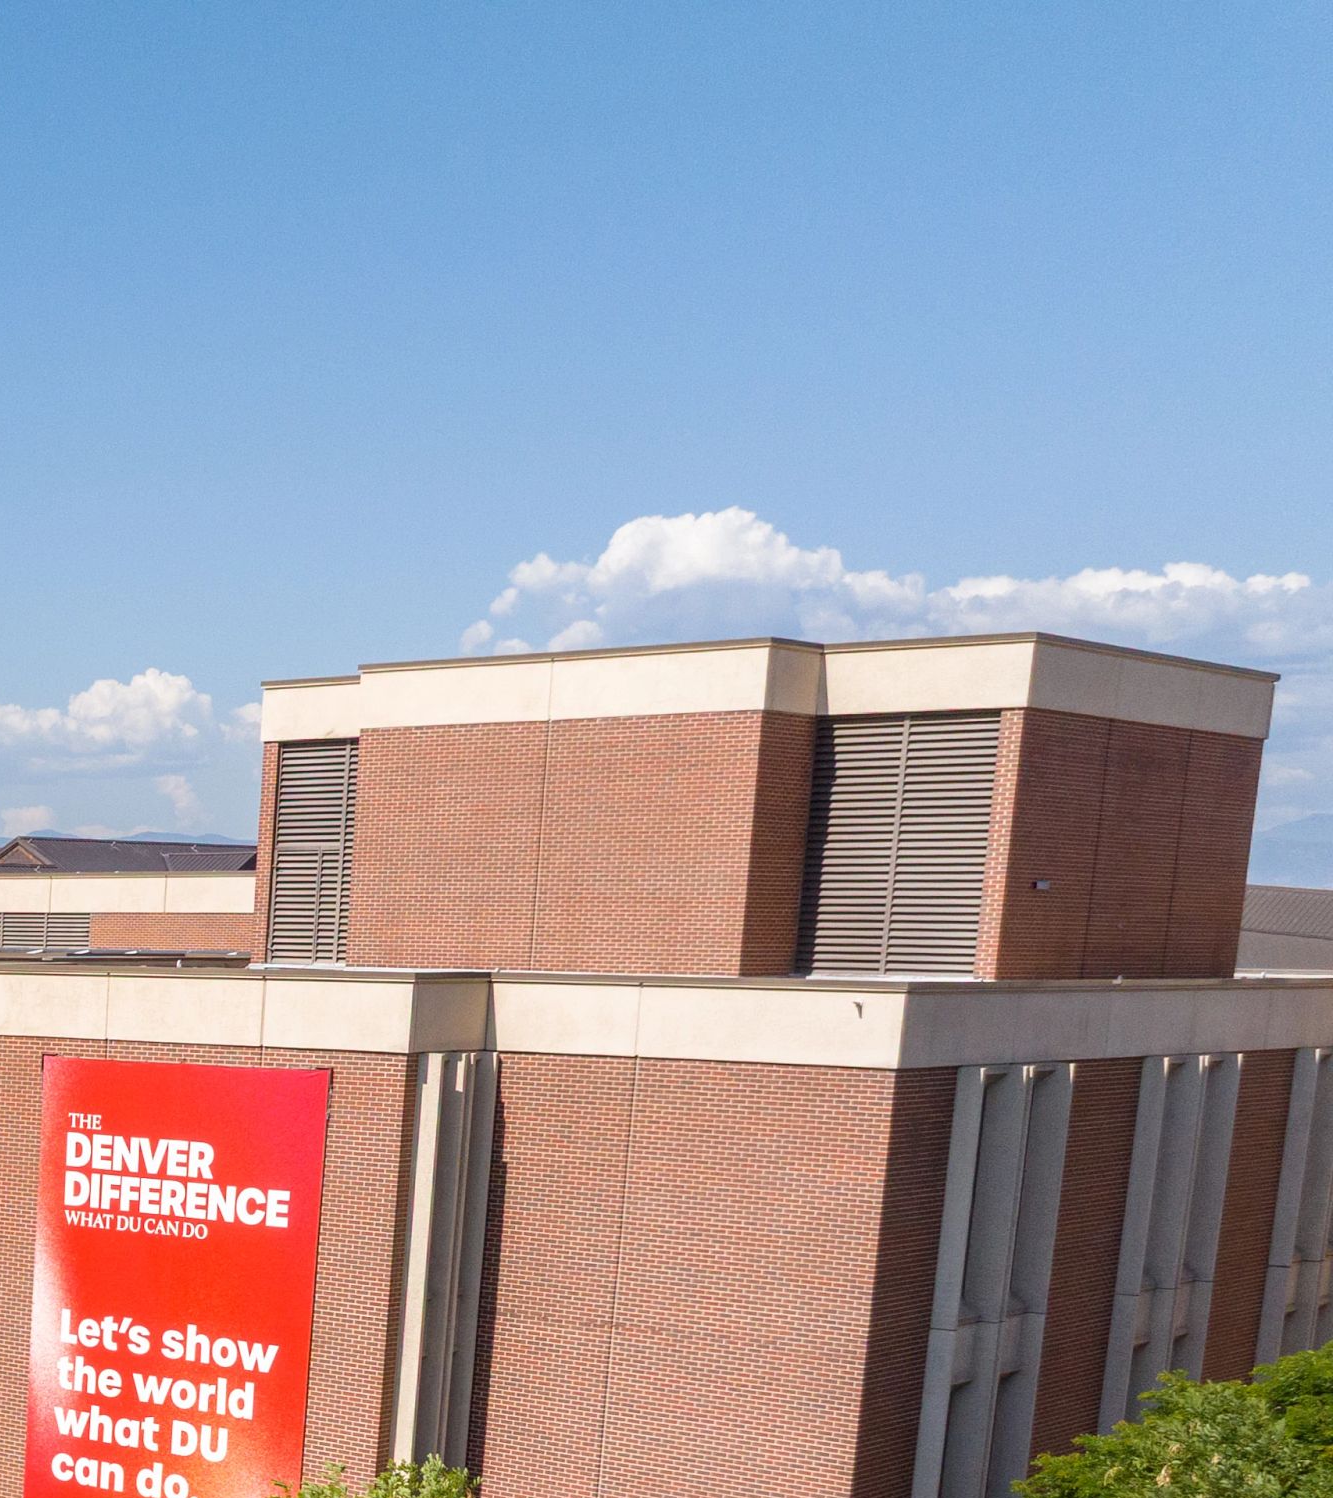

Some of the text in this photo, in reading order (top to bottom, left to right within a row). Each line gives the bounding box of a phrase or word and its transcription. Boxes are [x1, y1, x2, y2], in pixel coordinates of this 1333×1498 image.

[69, 1112, 102, 1131] THE
[66, 1132, 214, 1179] DENVER
[64, 1170, 291, 1228] DIFFERENCE
[64, 1210, 208, 1240] WHAT DU CAN DO
[60, 1308, 279, 1373] Let’s show
[56, 1356, 255, 1420] the world
[53, 1405, 228, 1462] what DU
[51, 1452, 124, 1492] can
